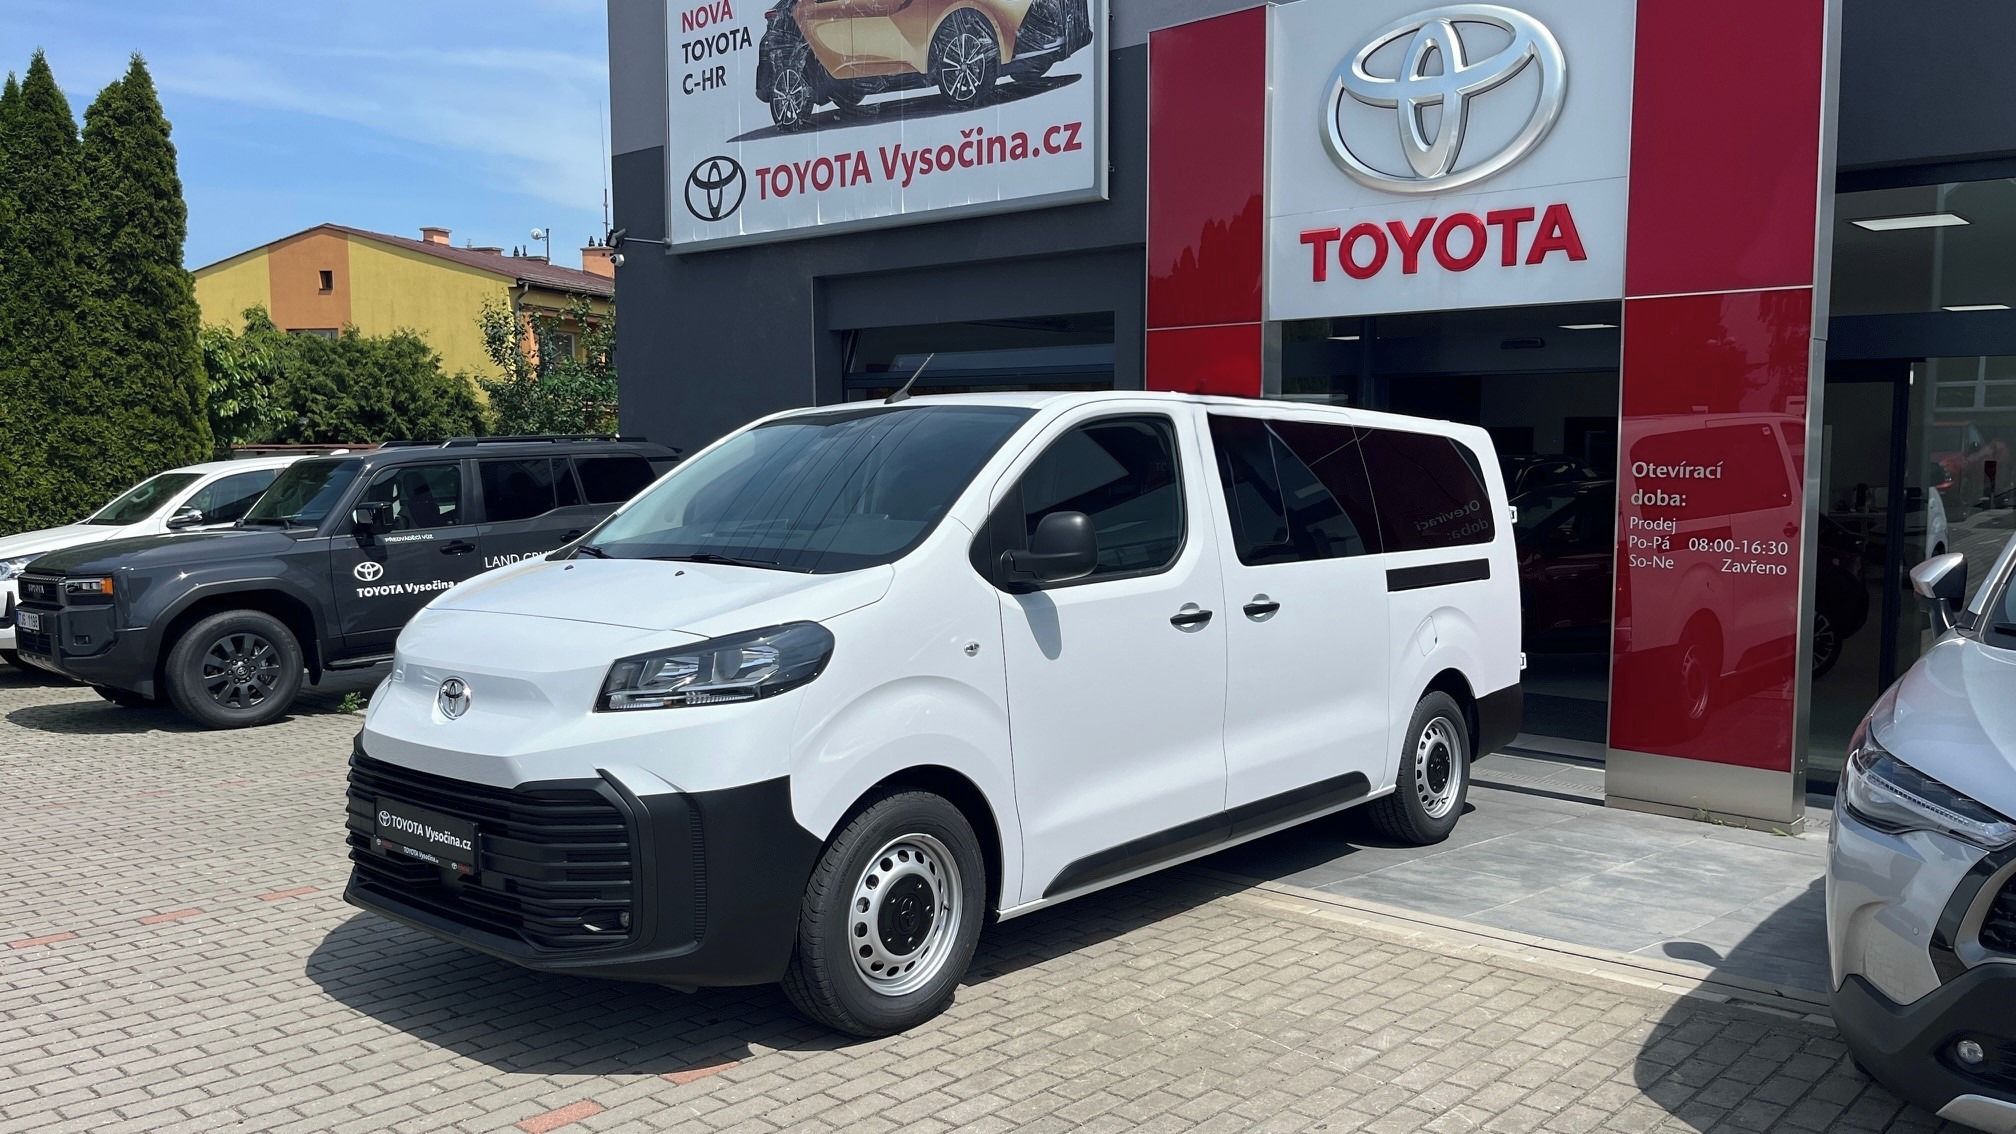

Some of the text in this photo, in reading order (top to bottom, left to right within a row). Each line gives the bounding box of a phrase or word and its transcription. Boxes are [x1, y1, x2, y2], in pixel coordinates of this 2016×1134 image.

[681, 26, 752, 64] TOYOTA
[682, 65, 727, 95] C-HR
[755, 121, 1083, 200] TOYOTA Vysočina.cz
[1299, 202, 1588, 283] TOYOTA
[1631, 460, 1724, 479] Otevírací
[1630, 489, 1687, 507] doba:
[1629, 516, 1677, 535] Prodej
[1628, 534, 1789, 556] Po-Pá 08:00-16:30
[484, 553, 520, 569] LAND
[1628, 553, 1788, 576] So-Ne Zavřeno
[356, 584, 404, 598] TOYOTA
[391, 815, 472, 851] TOYOTA Vysočina.cz
